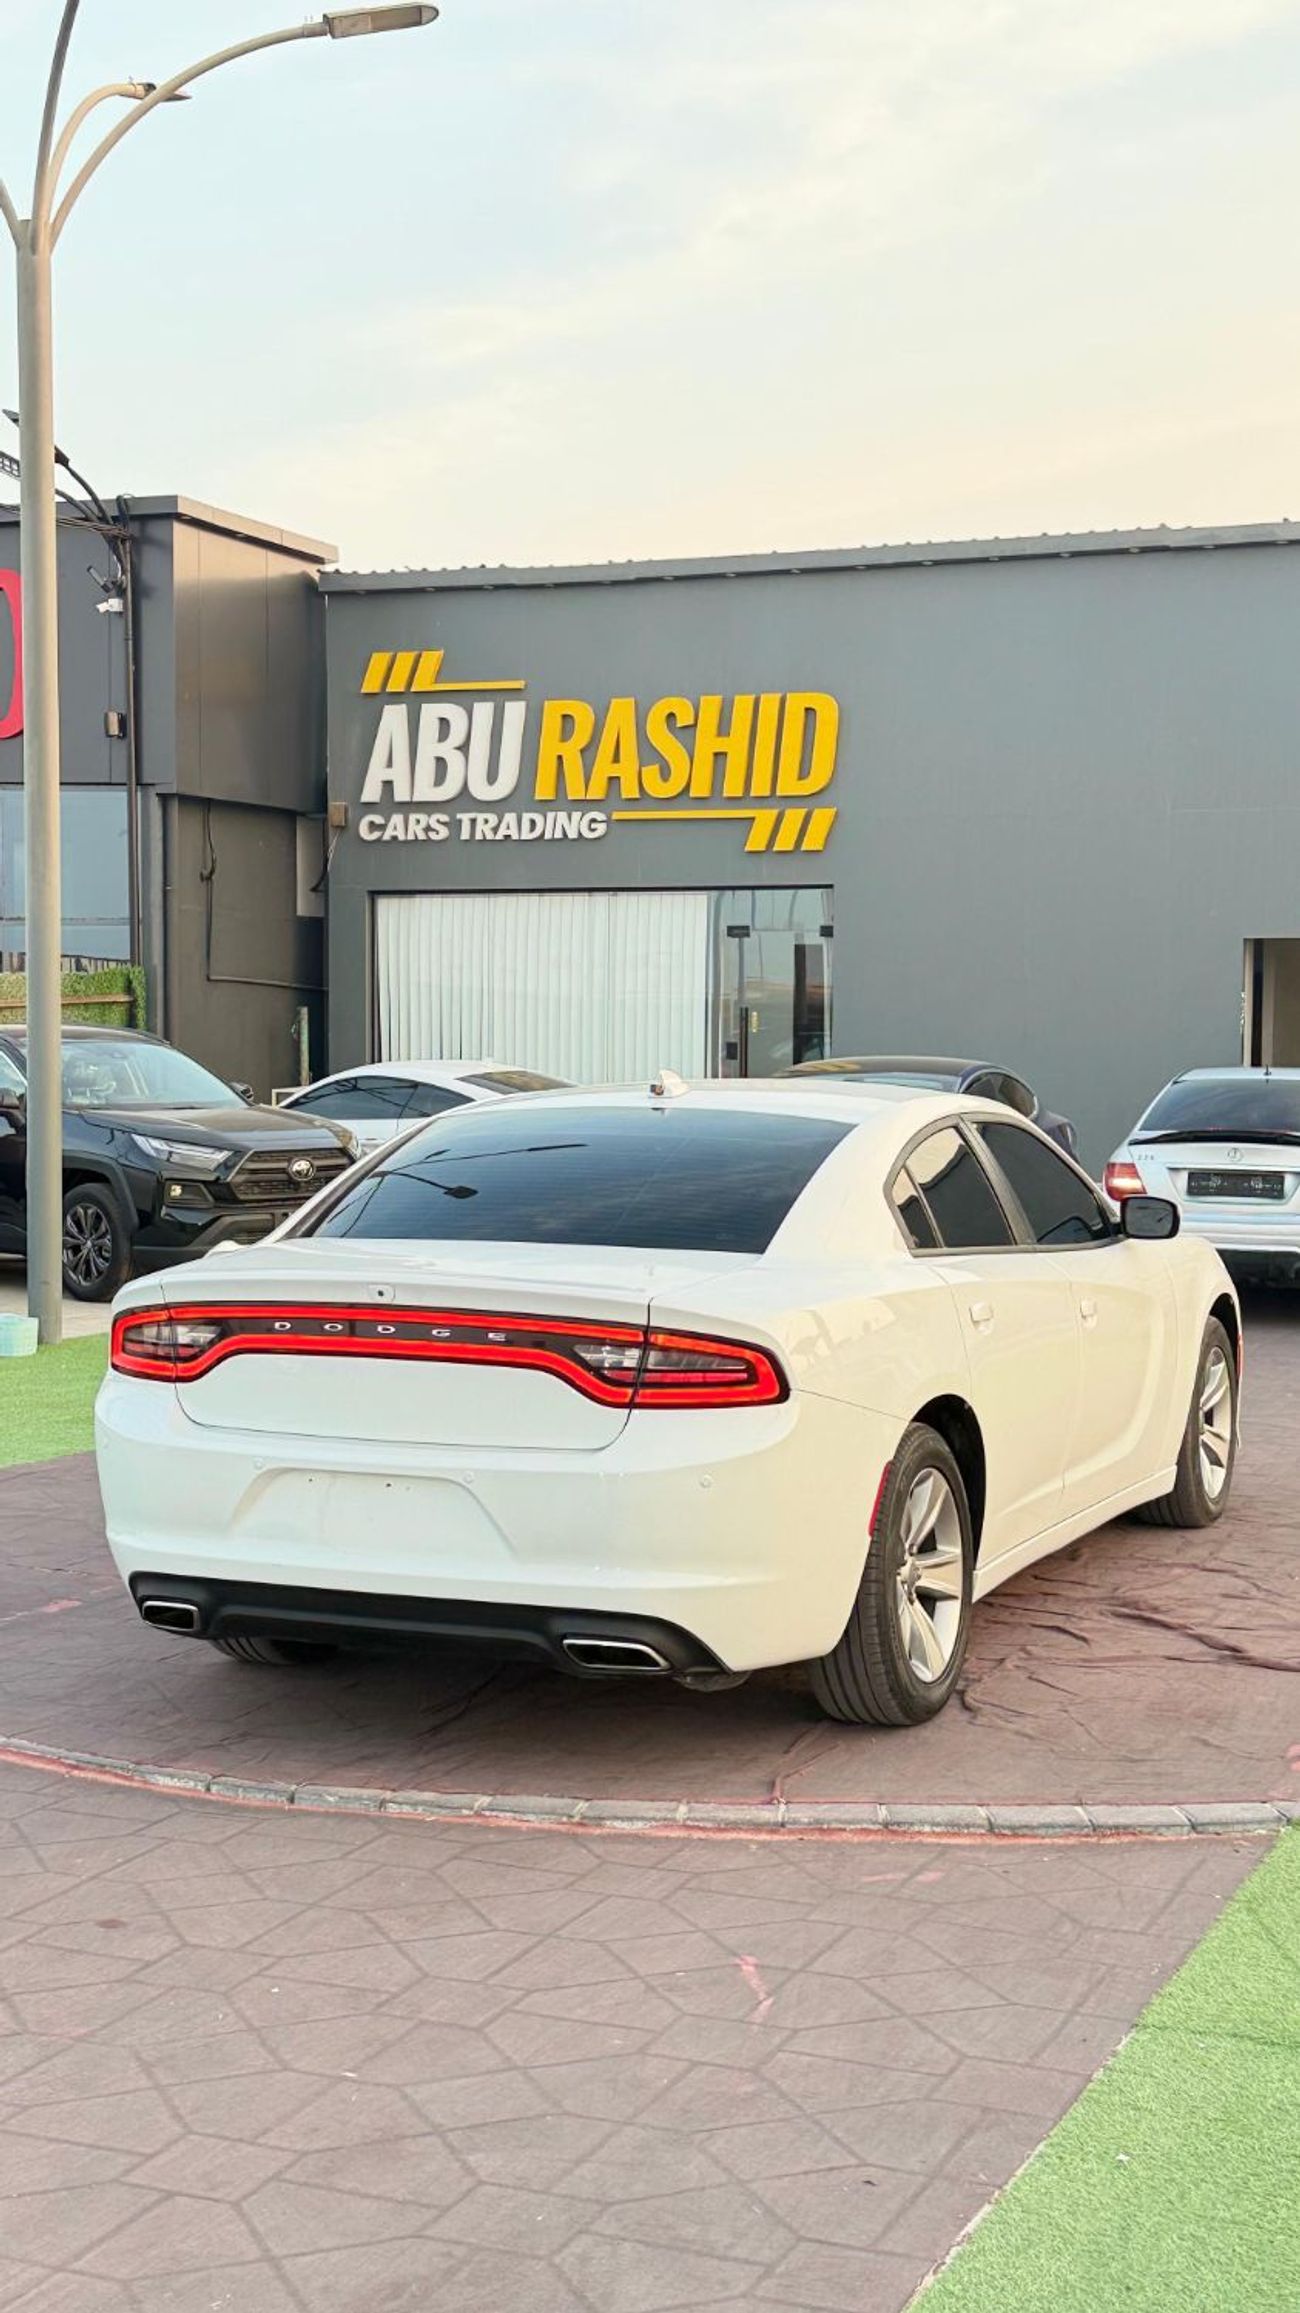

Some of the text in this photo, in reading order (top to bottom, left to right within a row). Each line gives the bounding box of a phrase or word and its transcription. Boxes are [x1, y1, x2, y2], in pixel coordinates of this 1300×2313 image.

[360, 692, 839, 803] ABU RASHID
[358, 810, 608, 842] CARS TRADING
[273, 1320, 507, 1342] DODGE
